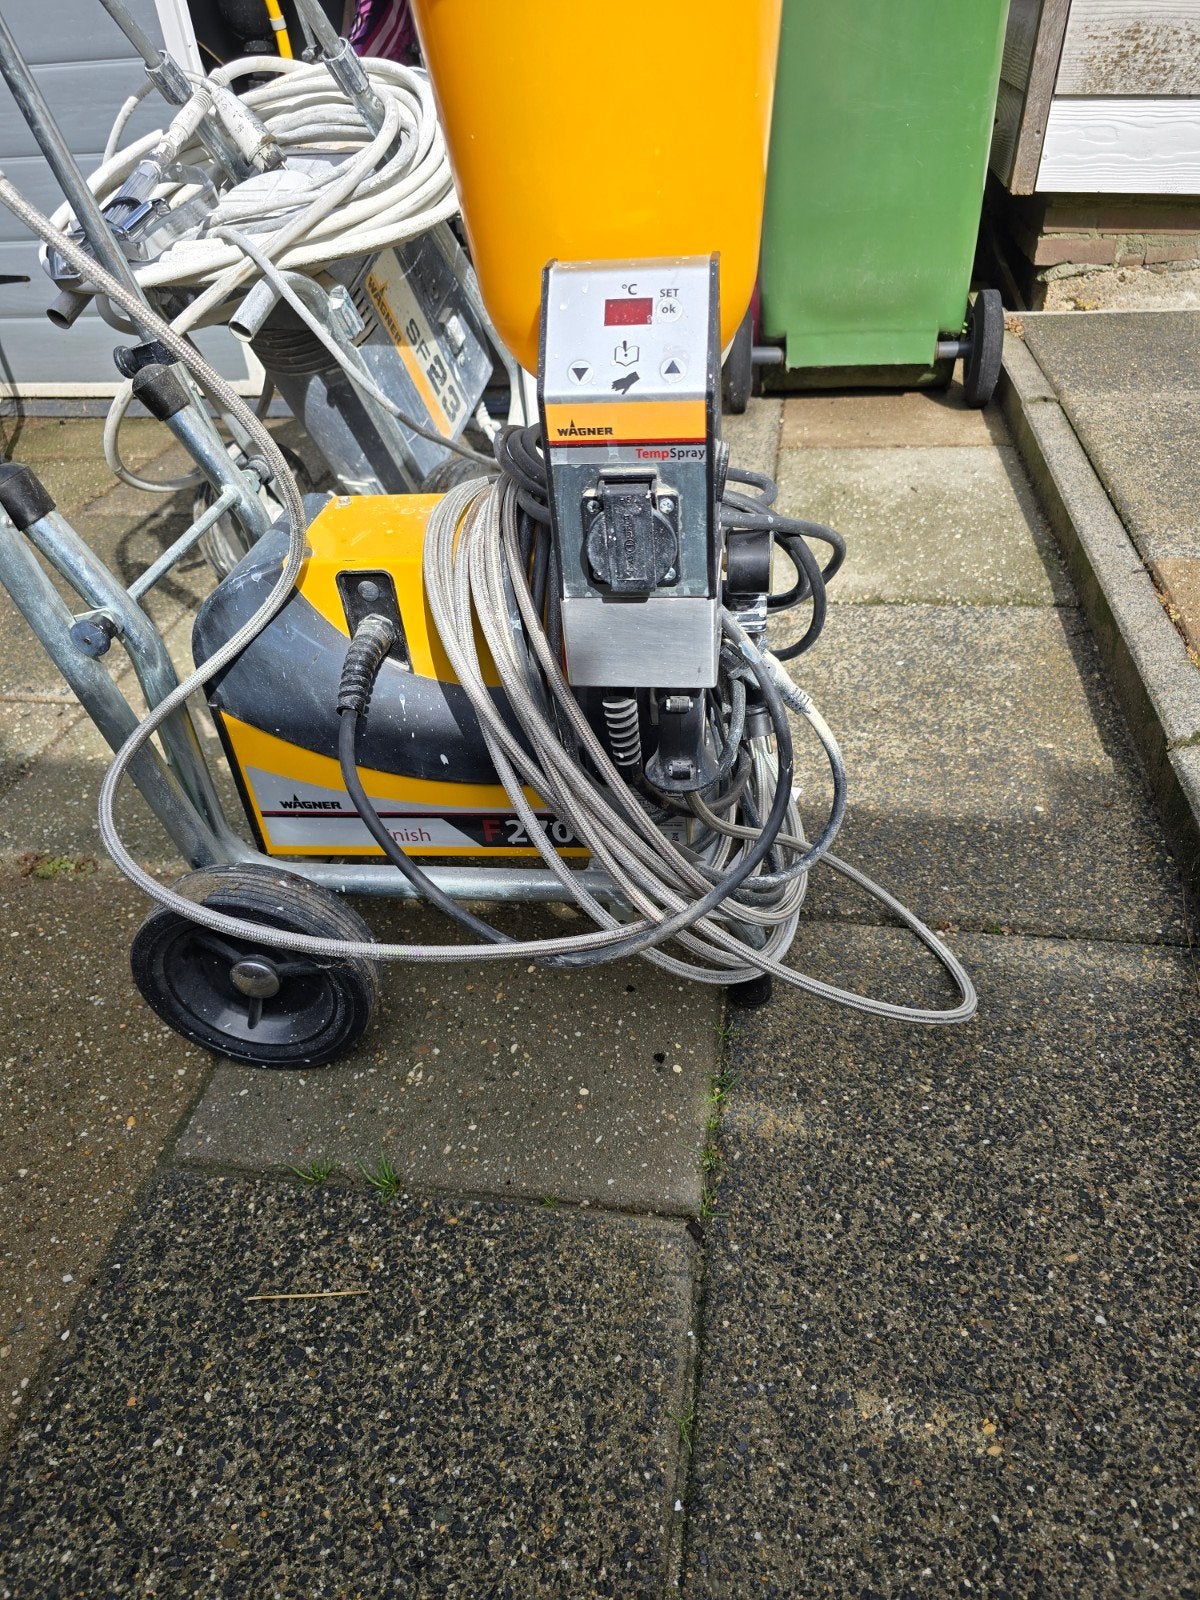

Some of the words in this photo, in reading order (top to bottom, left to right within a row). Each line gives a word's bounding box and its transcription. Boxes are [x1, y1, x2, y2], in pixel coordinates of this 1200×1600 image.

[659, 288, 680, 298] SET
[367, 274, 402, 344] WAGNER
[661, 304, 676, 314] ok
[557, 421, 614, 437] WAGNER
[635, 448, 706, 460] TempSpray
[279, 795, 343, 810] WAGNER
